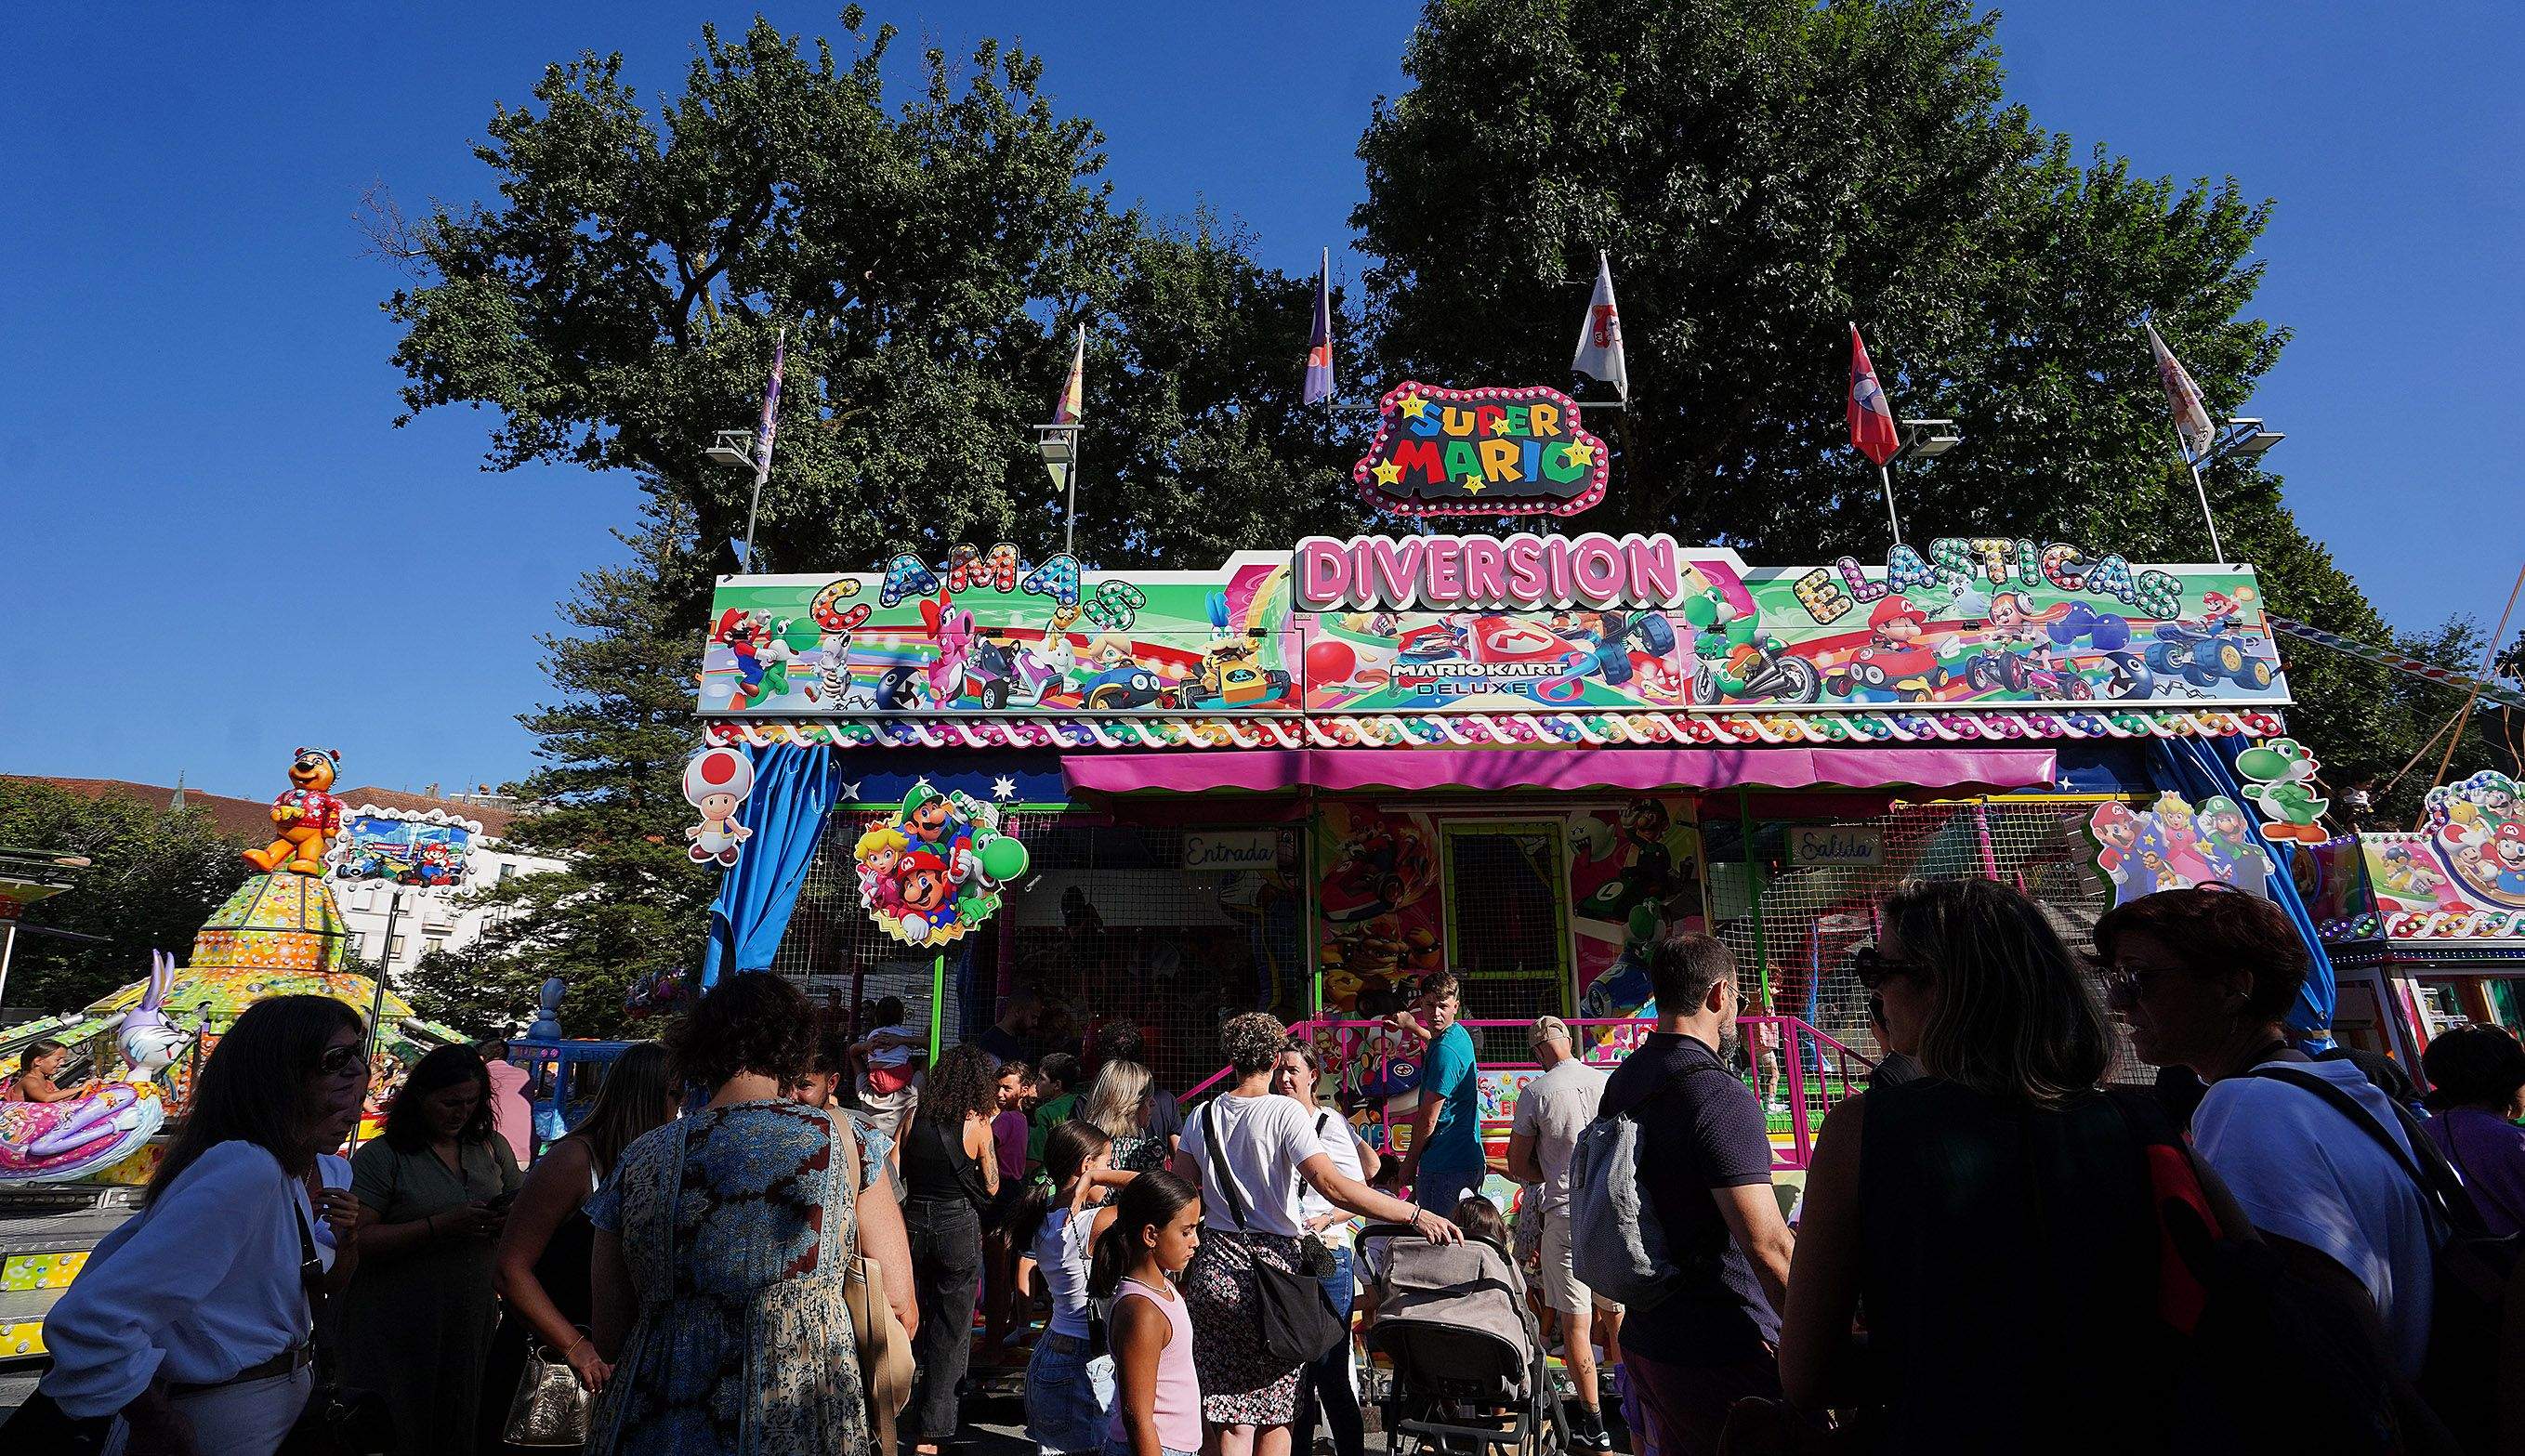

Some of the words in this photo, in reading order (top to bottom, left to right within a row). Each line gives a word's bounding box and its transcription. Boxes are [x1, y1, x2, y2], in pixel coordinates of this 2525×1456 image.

[1408, 403, 1559, 438] SUPER
[1392, 439, 1588, 484] MARIO
[809, 543, 1147, 633] CAMAS
[1306, 539, 1678, 602] DIVERSION
[1792, 537, 2185, 626] ELASTICAS
[1390, 662, 1569, 677] MARIOKART
[1538, 651, 1601, 702] 8
[1417, 682, 1529, 695] DELUXE
[1187, 837, 1275, 865] Entrada
[1802, 833, 1874, 860] Salida
